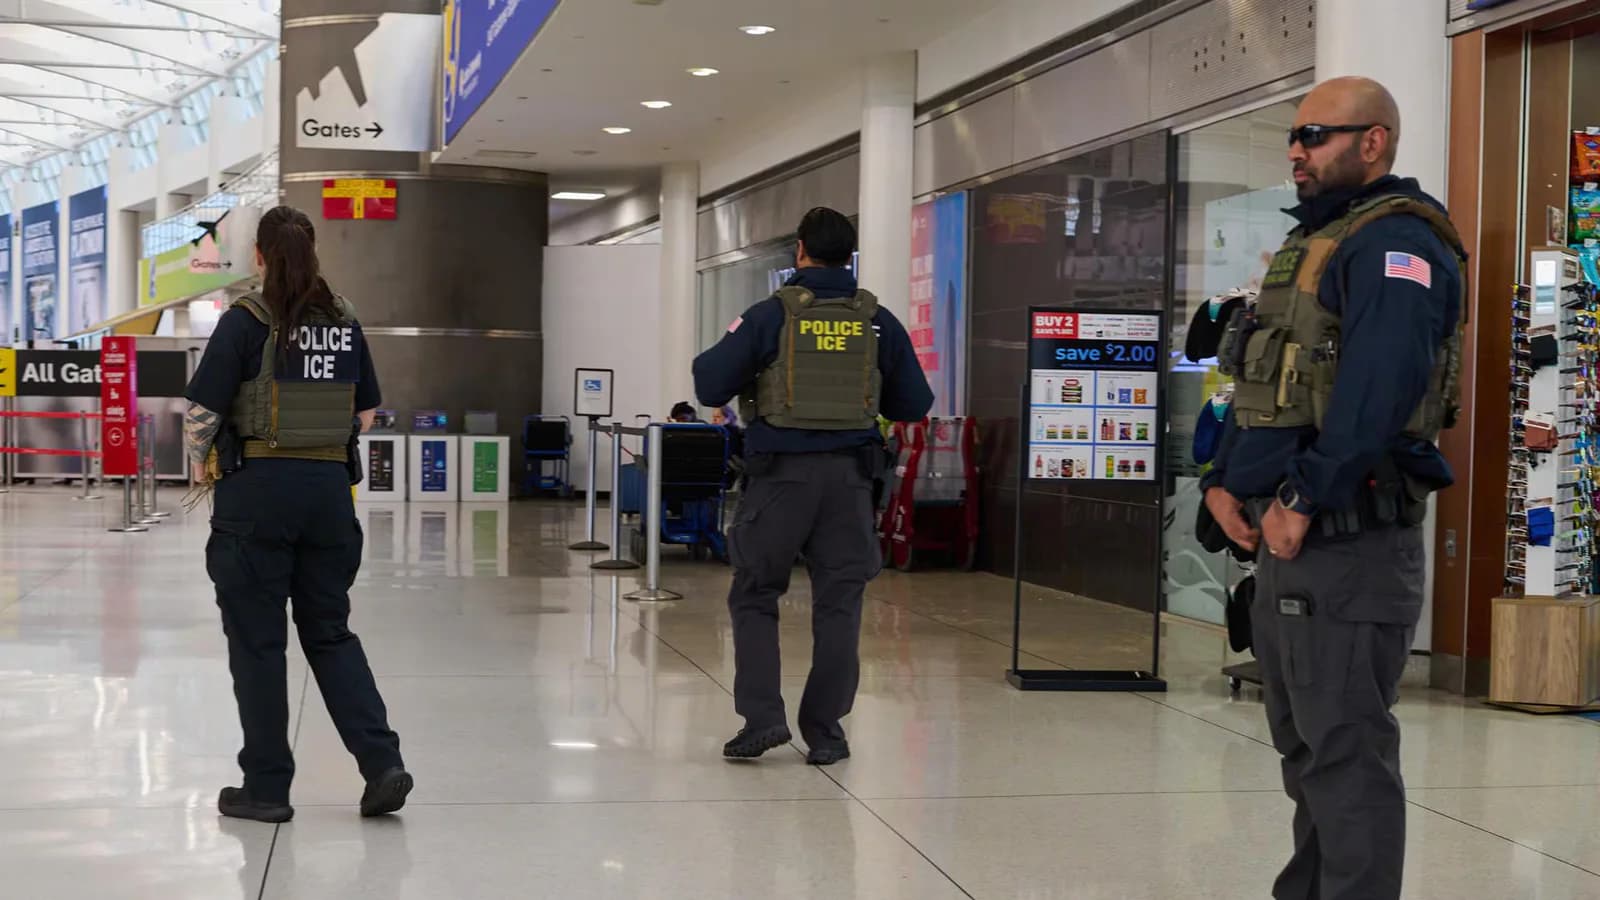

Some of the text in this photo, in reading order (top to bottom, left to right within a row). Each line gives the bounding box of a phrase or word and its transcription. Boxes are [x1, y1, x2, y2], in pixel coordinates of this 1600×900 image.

[302, 118, 361, 138] Gates
[191, 259, 221, 269] Gates
[799, 319, 864, 336] POLICE
[1035, 315, 1063, 327] BUY
[1064, 316, 1074, 327] 2
[816, 335, 847, 351] ICE
[1055, 343, 1156, 362] save $2.00
[22, 362, 56, 383] All
[60, 362, 102, 383] Gat
[303, 354, 336, 379] ICE
